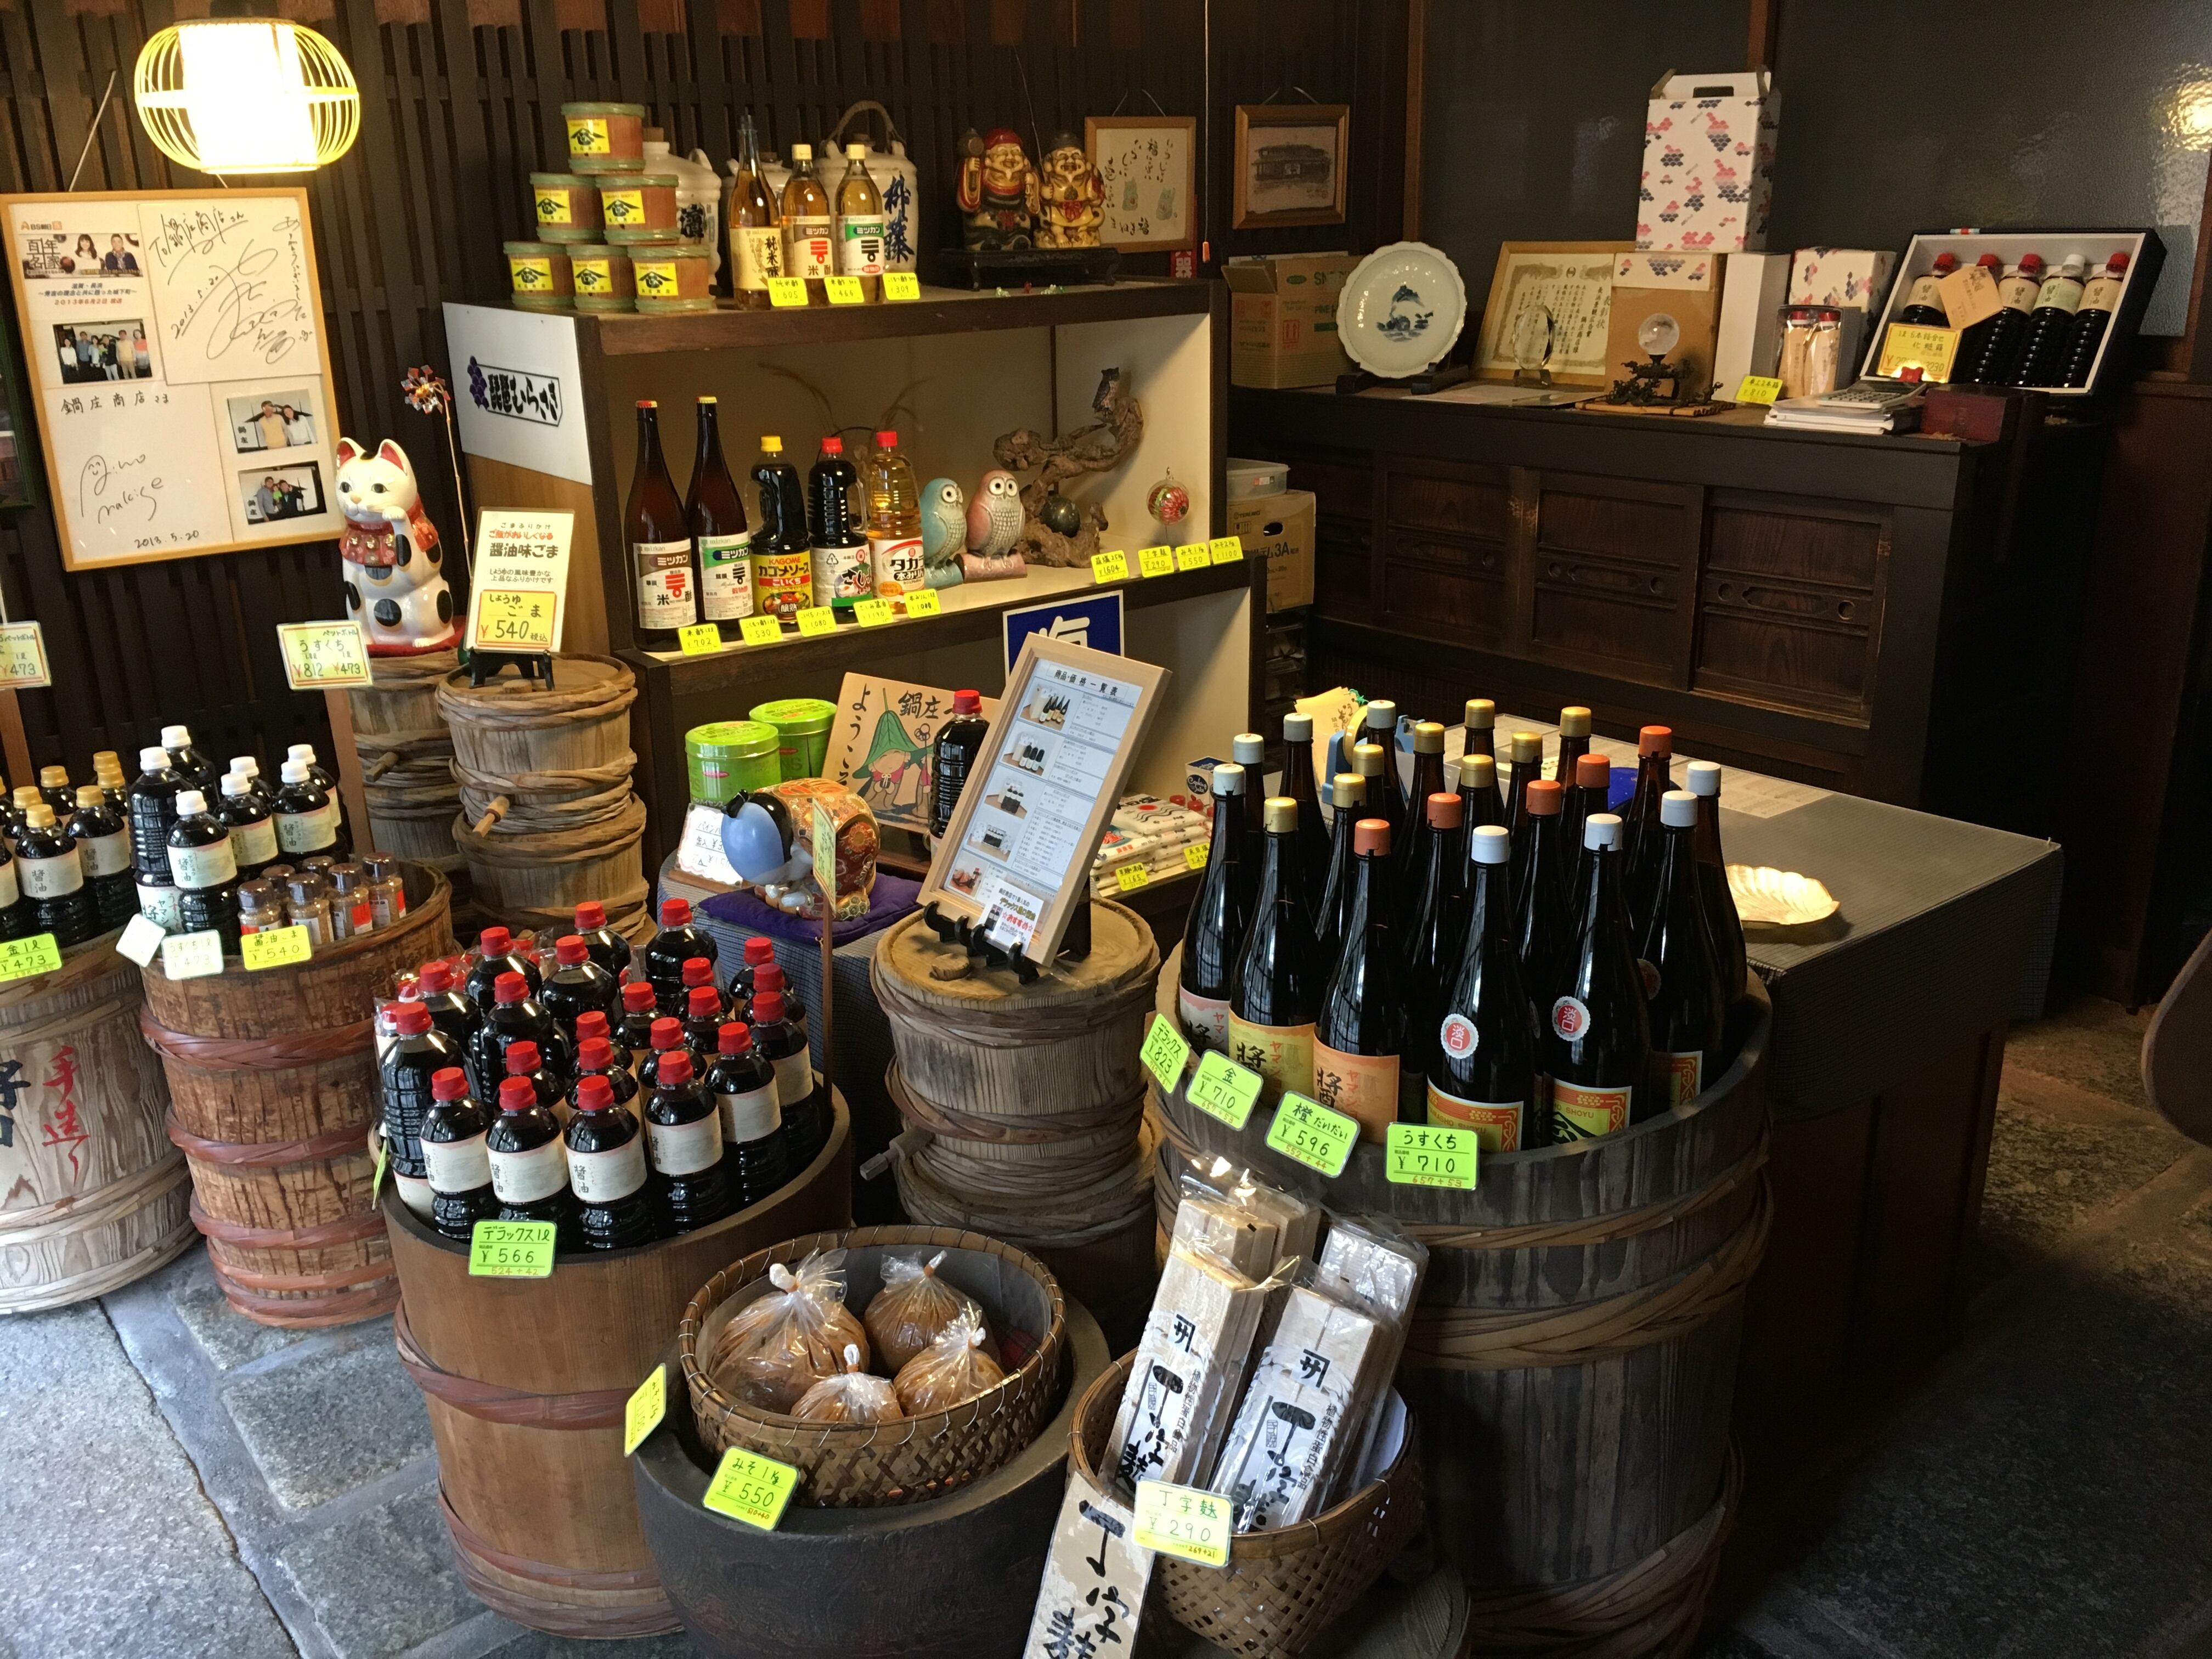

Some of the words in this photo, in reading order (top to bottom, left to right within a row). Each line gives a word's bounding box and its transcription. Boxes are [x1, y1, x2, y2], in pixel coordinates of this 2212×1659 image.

[805, 227, 829, 235] ミツカン
[856, 226, 881, 234] ミツカン
[27, 238, 58, 253] 百年
[30, 253, 61, 270] 名家
[134, 529, 200, 549] 2013.5.20
[488, 529, 554, 540] ご飯がおいしくなる
[489, 542, 559, 558] 醤油味ごま
[721, 548, 749, 559] ミツカン
[657, 554, 689, 566] ミツカン
[769, 556, 802, 565] KAGOME
[489, 567, 551, 577] しょうゆの風味豊かな
[758, 561, 810, 577] カゴメソース
[896, 569, 924, 580] 本みりん
[490, 575, 554, 584] 上品なふりかけです
[772, 577, 802, 586] こいくち
[489, 593, 521, 605] しょうゆ
[507, 604, 541, 618] ごま
[530, 632, 548, 642] 税込
[299, 639, 345, 652] うすくち
[837, 683, 871, 786] ようこそ
[1006, 913, 1029, 930] おすすめ
[1561, 1007, 1577, 1031] 淡口
[1156, 1023, 1182, 1059] デラックス
[1451, 1024, 1465, 1049] 淡口
[1222, 1067, 1237, 1085] 金
[1199, 1080, 1235, 1109] ¥710
[42, 1045, 92, 1188] 手造
[1292, 1102, 1314, 1124] 橙
[1565, 1108, 1594, 1119] SHOYU
[1281, 1123, 1330, 1156] ¥596
[1403, 1129, 1457, 1150] うすくち
[1398, 1155, 1455, 1173] ¥710
[482, 1248, 535, 1263] ¥566
[722, 1480, 774, 1507] ¥550
[1159, 1489, 1218, 1519] 丁字麩
[1149, 1516, 1211, 1542] ¥290
